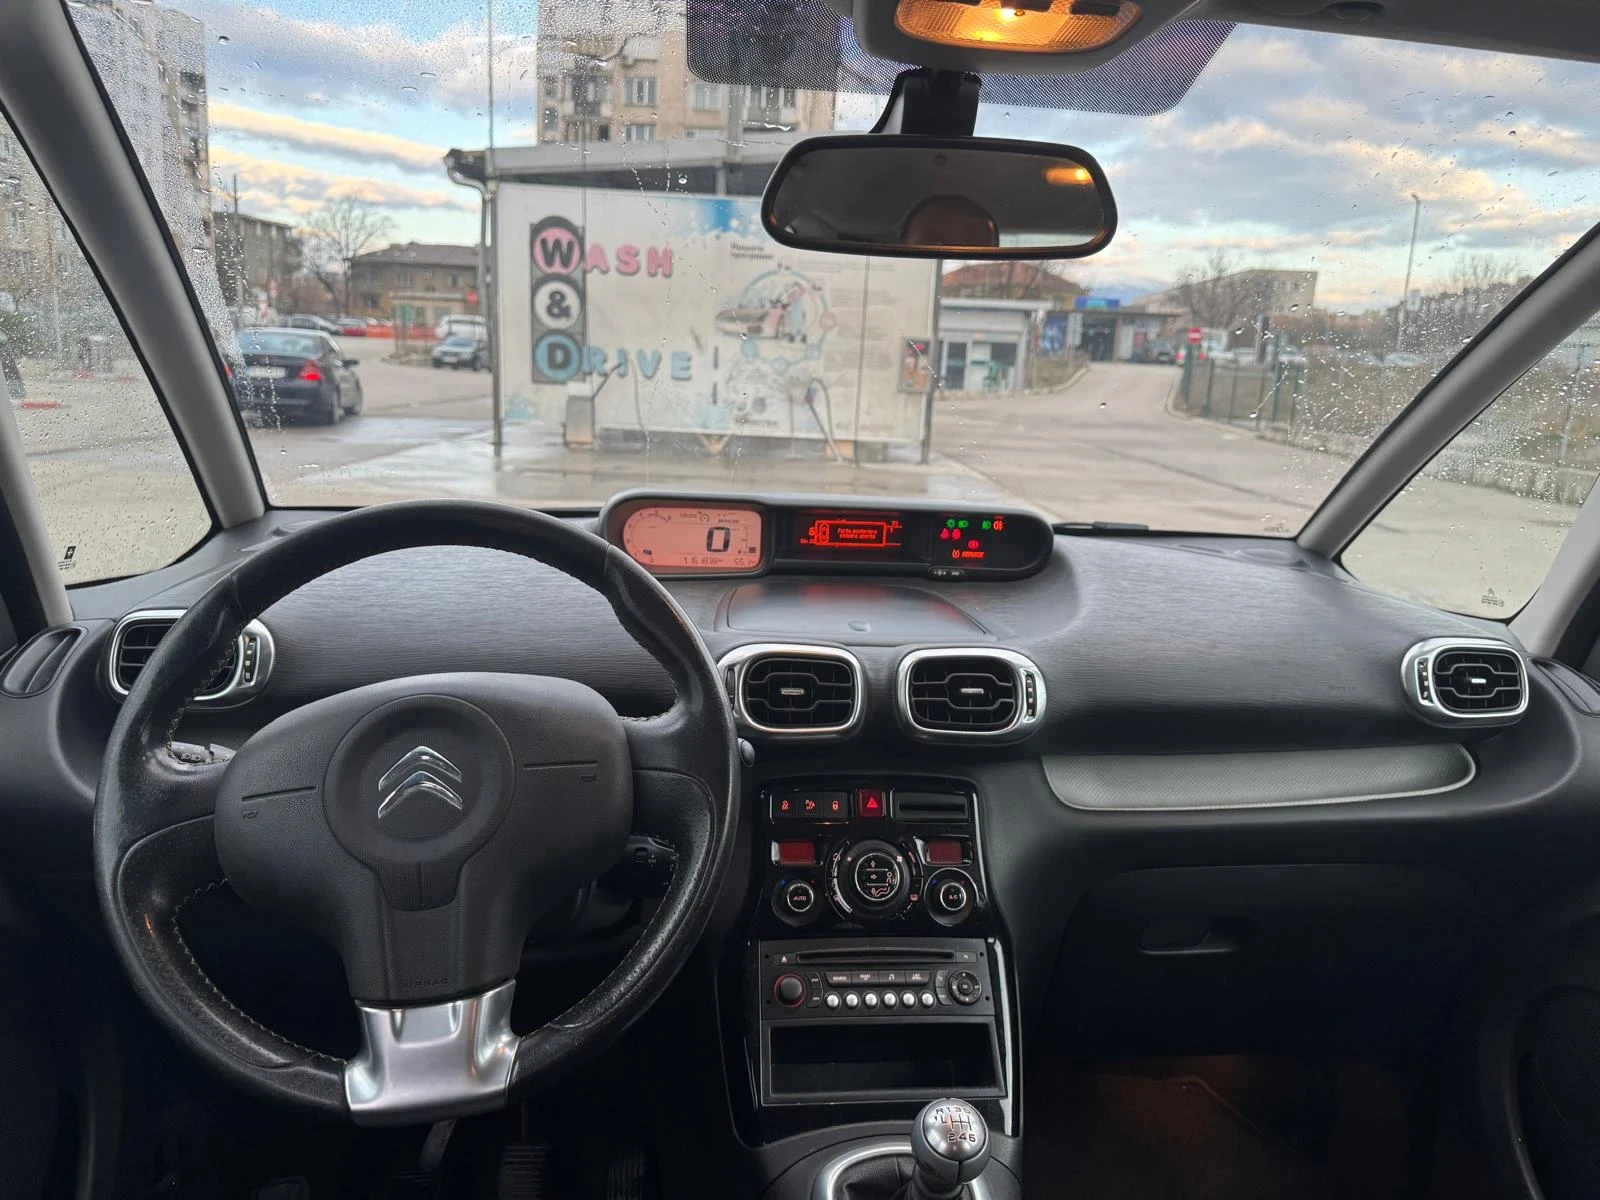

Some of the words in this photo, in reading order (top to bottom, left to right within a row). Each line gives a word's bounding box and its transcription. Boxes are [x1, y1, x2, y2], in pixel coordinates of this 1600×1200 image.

[536, 231, 675, 279] WASH
[546, 347, 694, 382] DRIVE
[706, 526, 731, 552] 0
